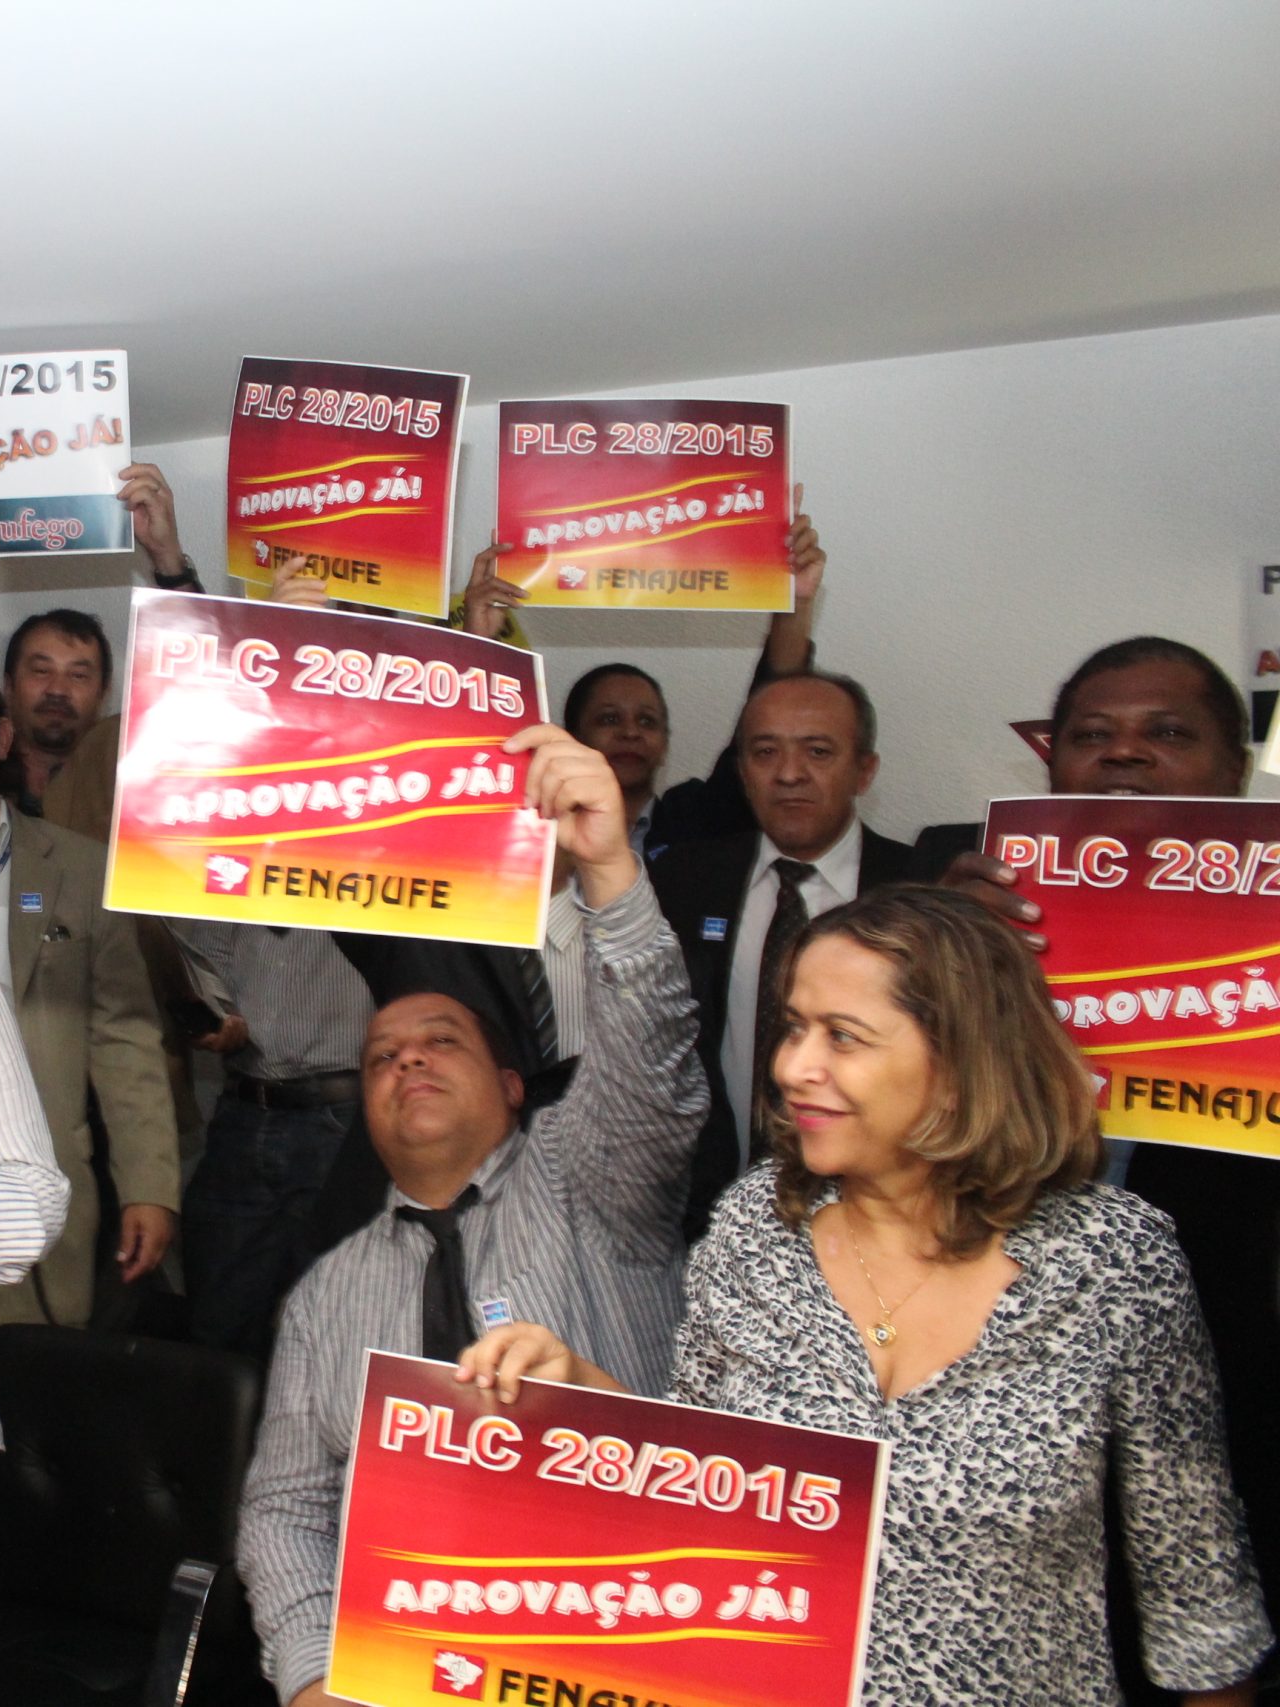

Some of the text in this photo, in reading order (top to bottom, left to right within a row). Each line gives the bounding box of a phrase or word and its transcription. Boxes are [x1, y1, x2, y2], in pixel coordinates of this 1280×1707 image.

[67, 414, 124, 450] JÁ!
[241, 382, 442, 438] PLC 28/2015
[512, 422, 774, 457] PLC 28/2015
[239, 467, 422, 517] APROVAÇÃO JÁ!
[526, 483, 765, 548] APROVAÇÃO JÁ!
[273, 546, 382, 586] FEAJUFE
[596, 567, 730, 594] FENAJUFE
[151, 631, 526, 718] PLC 28/2015
[162, 752, 515, 826] APROVAÇÃO JÁ!
[262, 865, 452, 910] FENAJUFE
[1000, 834, 1129, 888] PLC
[380, 1396, 841, 1531] PLC 28/2015
[383, 1571, 810, 1629] APROVAÇÃO JÁ!
